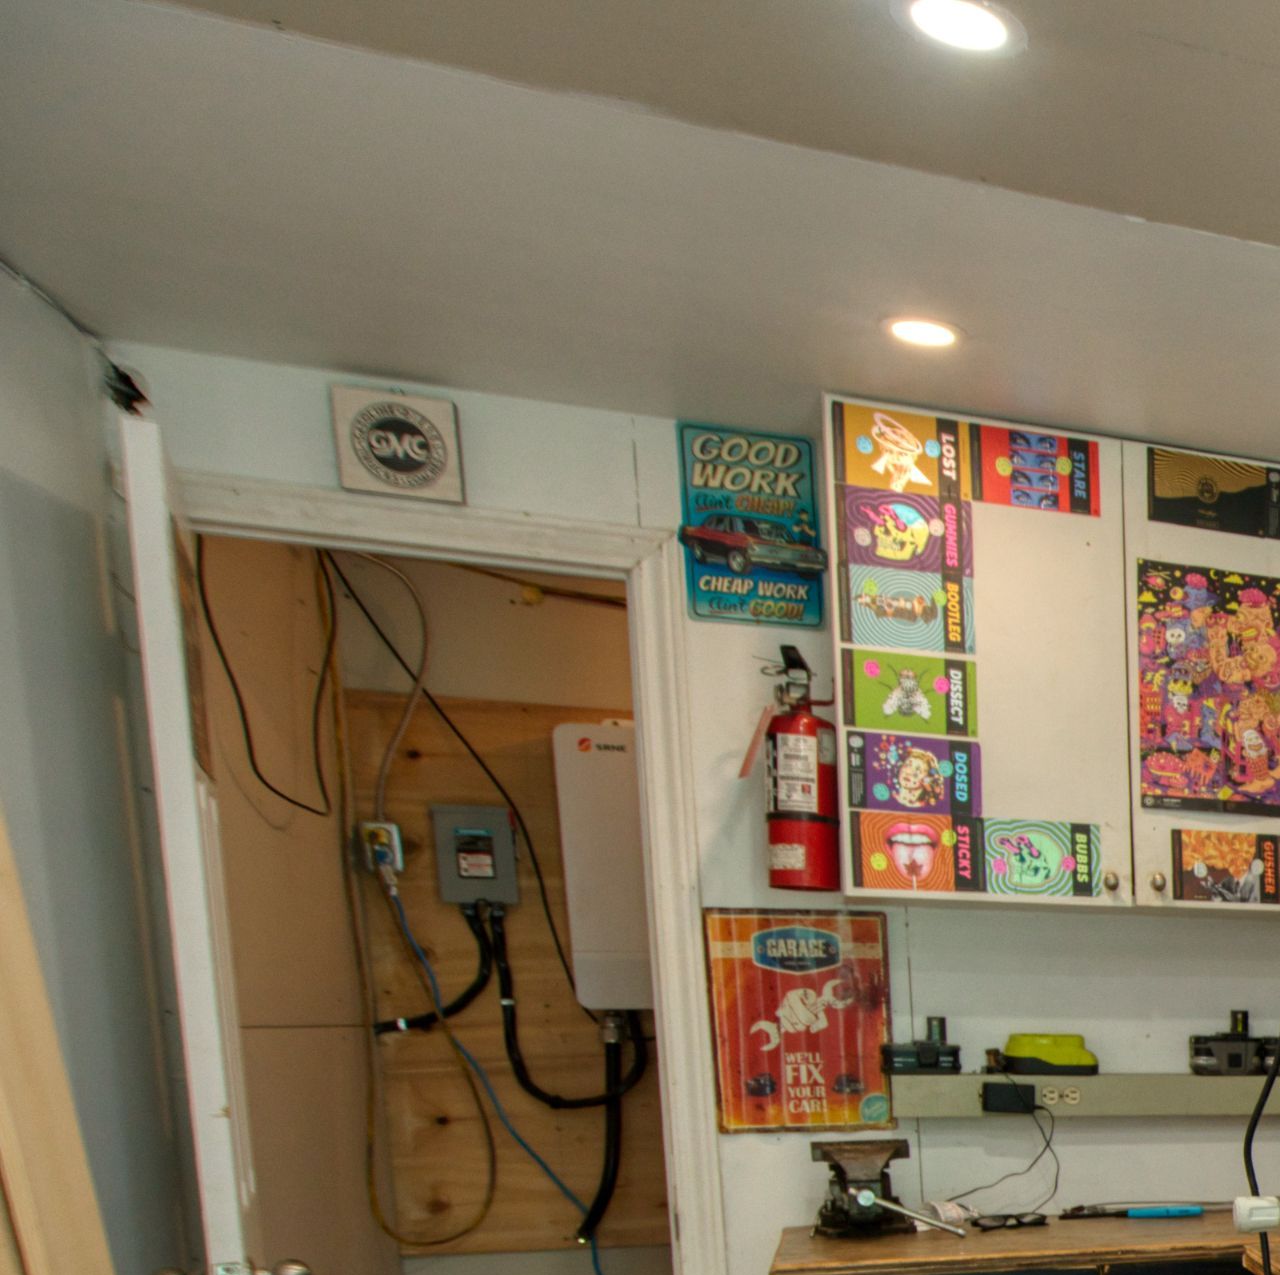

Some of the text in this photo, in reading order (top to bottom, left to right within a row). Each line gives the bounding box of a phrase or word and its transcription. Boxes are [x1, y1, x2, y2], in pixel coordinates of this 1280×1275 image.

[368, 429, 430, 462] GMC
[692, 433, 800, 469] GOOD
[941, 432, 957, 480] LOST
[692, 462, 801, 497] WORK
[1073, 451, 1087, 499] STARE
[735, 495, 795, 516] CHEAP!
[944, 504, 959, 568] GUMMIES
[699, 575, 809, 600] CHEAP WORK
[749, 599, 805, 620] GOOD!
[946, 581, 961, 643] BOOTLEG
[949, 668, 964, 725] DISSECT
[953, 751, 968, 802] DOSED
[956, 824, 972, 880] STICKY
[1074, 832, 1089, 883] BUBBS
[1263, 840, 1276, 895] GUSHER
[767, 938, 827, 958] GARAGE
[785, 1052, 823, 1064] WE'LL
[785, 1064, 825, 1084] FIX
[788, 1086, 826, 1099] YOUR
[789, 1099, 827, 1113] CAR!
